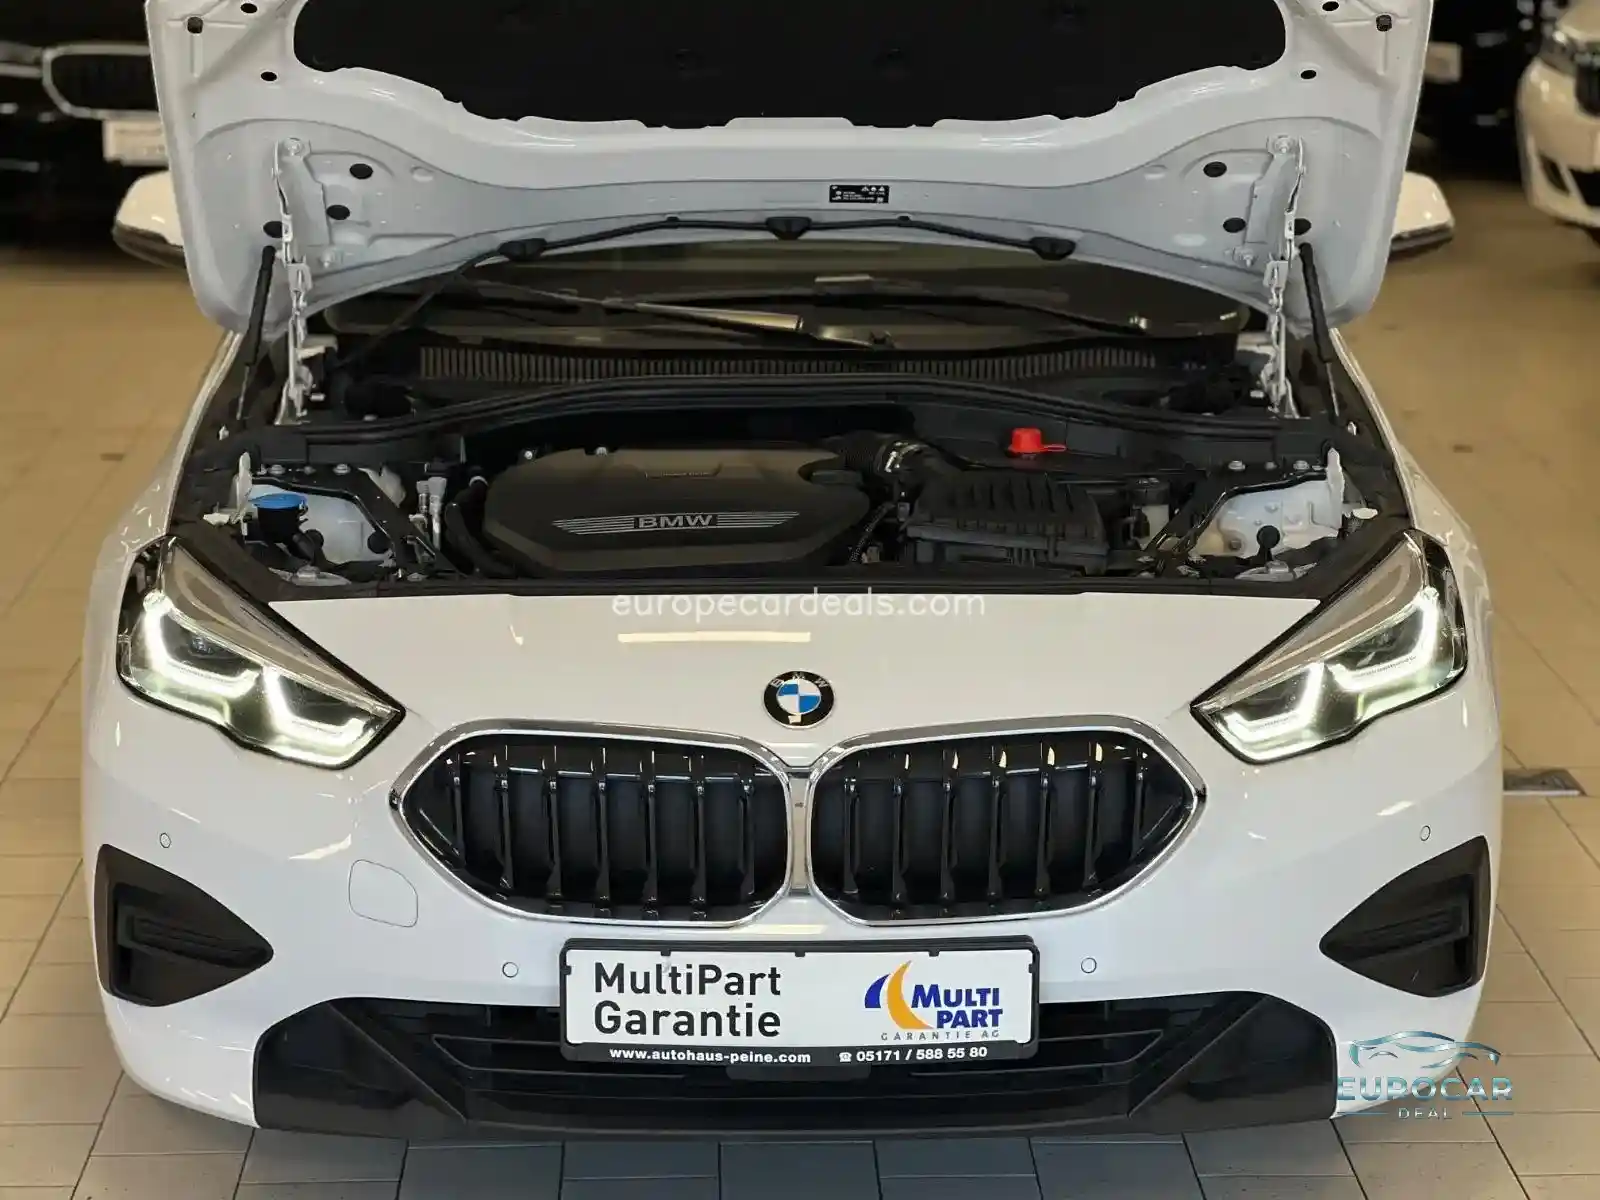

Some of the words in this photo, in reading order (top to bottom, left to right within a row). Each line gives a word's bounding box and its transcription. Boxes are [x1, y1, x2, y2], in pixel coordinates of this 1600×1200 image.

[638, 514, 713, 528] BMW
[594, 962, 781, 996] MultiPart
[594, 999, 781, 1037] Garantie
[936, 1008, 1003, 1029] PART
[880, 1030, 972, 1041] GARANTIE
[980, 1029, 1000, 1038] AG
[609, 1048, 811, 1064] www.autohaus-peine.com
[855, 1049, 900, 1062] 05171
[915, 1048, 944, 1060] 588
[946, 1047, 966, 1059] 55
[968, 1046, 988, 1058] 80
